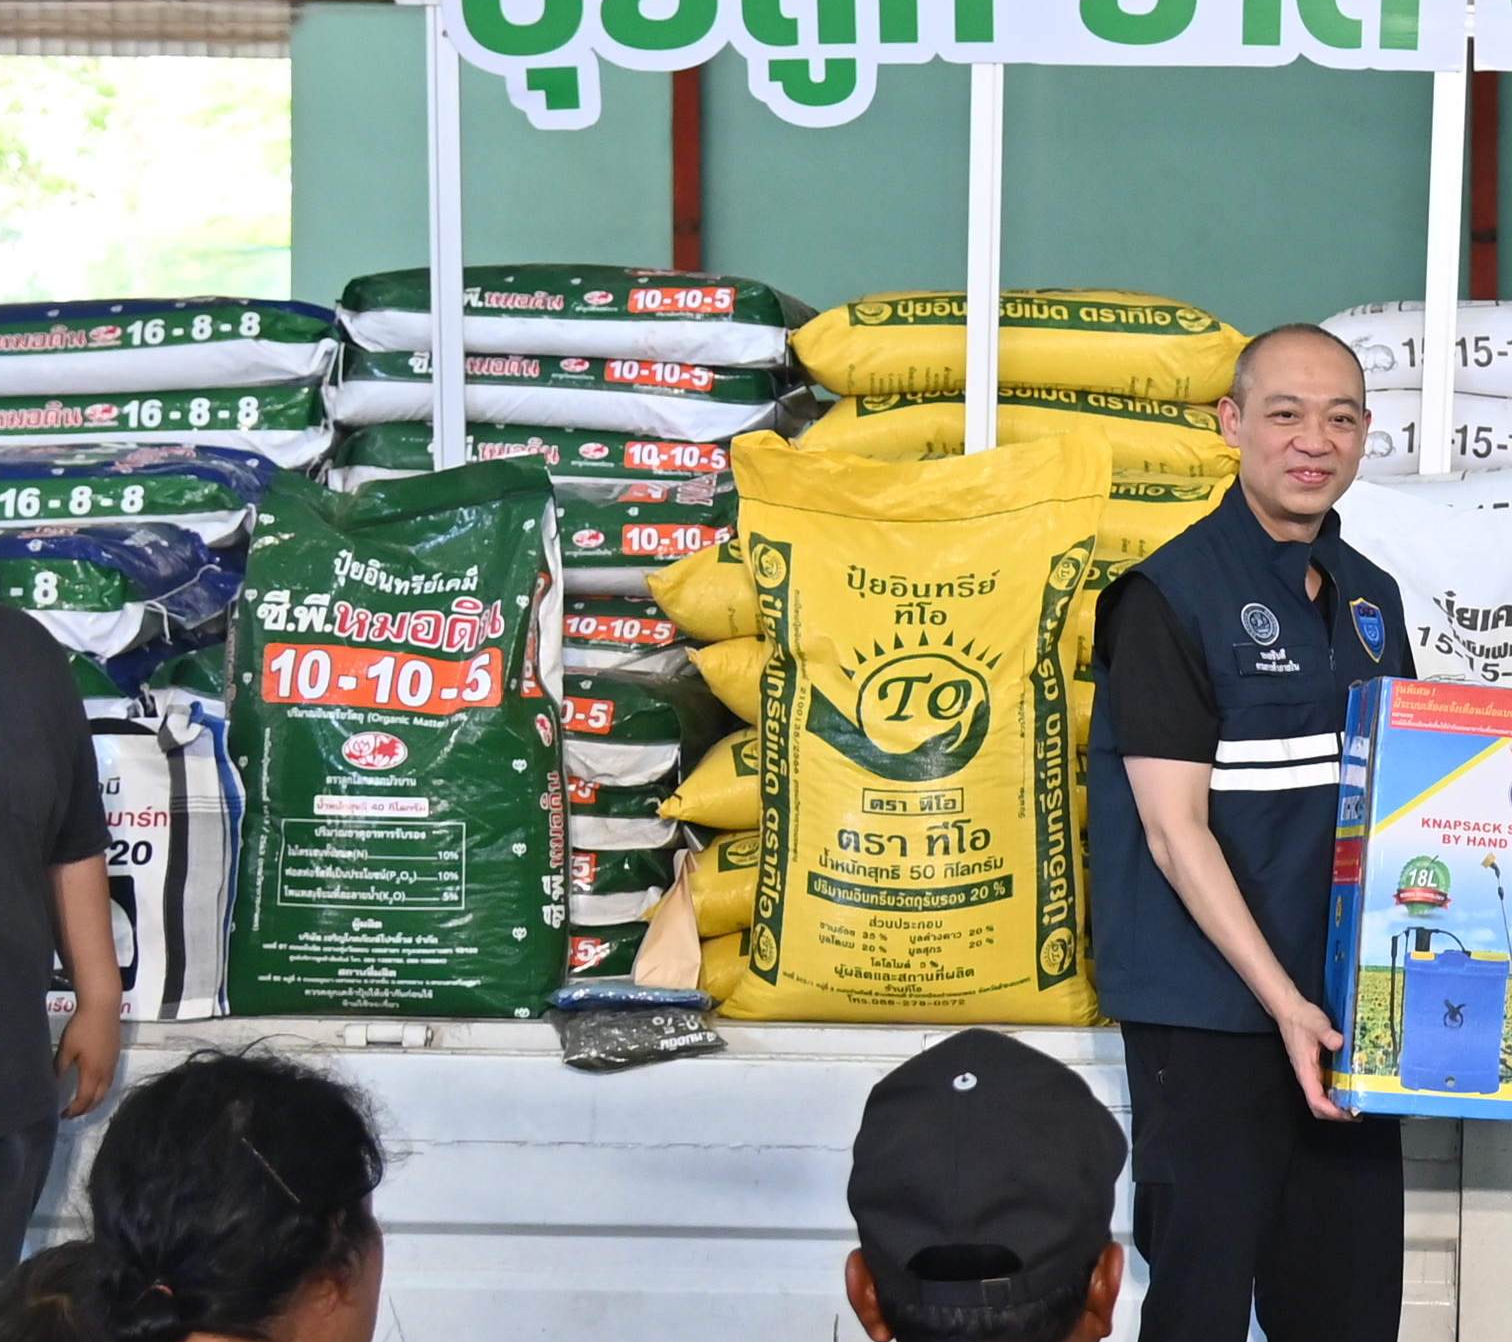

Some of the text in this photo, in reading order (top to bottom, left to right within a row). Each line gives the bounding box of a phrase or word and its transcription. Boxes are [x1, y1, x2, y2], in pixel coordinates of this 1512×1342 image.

[632, 288, 731, 310] 10-10-5
[1080, 307, 1172, 325] ตราทีโอ
[610, 358, 712, 387] 10-10-5
[629, 444, 727, 470] 10-10-5
[334, 550, 478, 595] ปุ๋ยอินทรีย์เคมี
[847, 565, 1000, 598] ปุ๋ยอินทรีย์
[257, 590, 504, 653] ซี.พี.หมอดิน
[895, 602, 947, 625] ทีโอ
[565, 616, 673, 640] 10-10-5
[270, 648, 492, 707] 10-10-5
[870, 798, 907, 812] ตรา
[1421, 817, 1502, 834] KNAPSACK
[838, 819, 991, 857] ตรา ทีโอ
[1442, 834, 1462, 845] BY
[1466, 835, 1508, 849] HAND
[438, 850, 459, 860] 10%
[819, 847, 1004, 883] น้ำหนักสุทธิ 50 กิโลกรัม
[438, 871, 459, 881] 10%
[1408, 869, 1438, 888] 18L
[442, 892, 459, 902] 5%
[970, 881, 1005, 902] 20 %
[869, 916, 943, 930] ส่วนประกอบ
